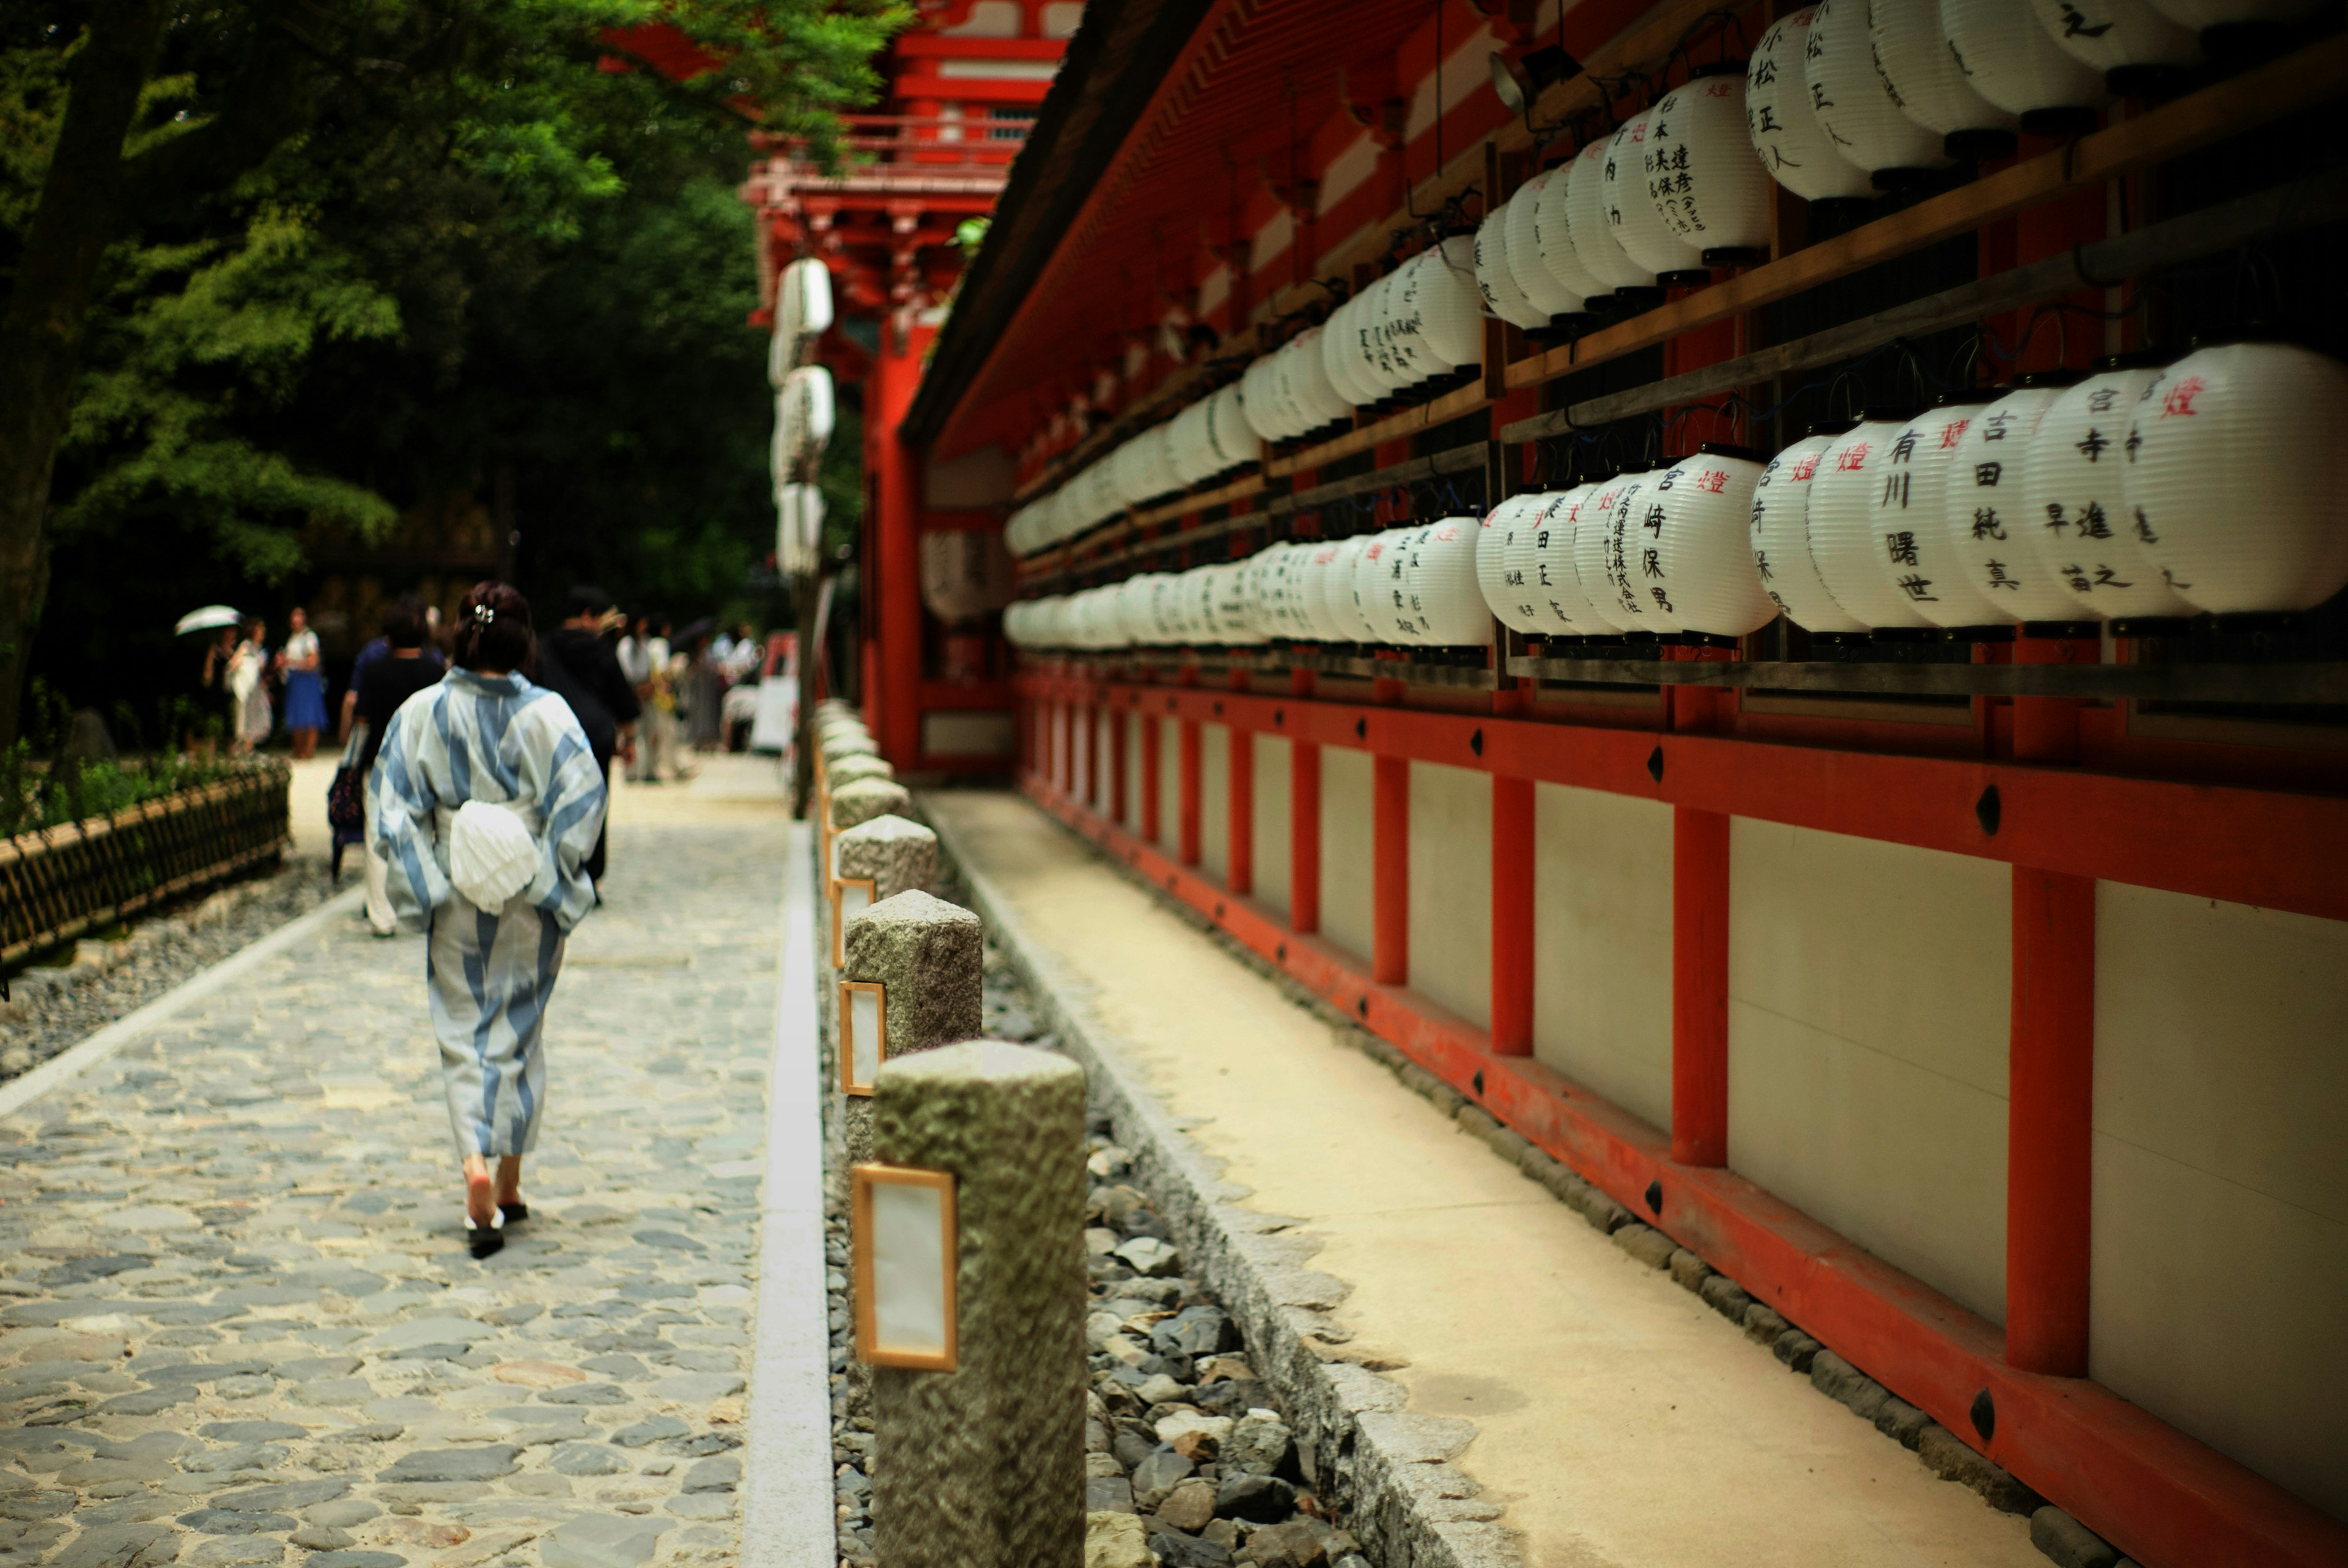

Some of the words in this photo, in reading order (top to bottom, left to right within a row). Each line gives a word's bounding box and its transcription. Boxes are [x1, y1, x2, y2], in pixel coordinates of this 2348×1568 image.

[2160, 375, 2207, 421] 燈
[1836, 441, 1874, 474] 燈
[1696, 470, 1732, 494] 燈
